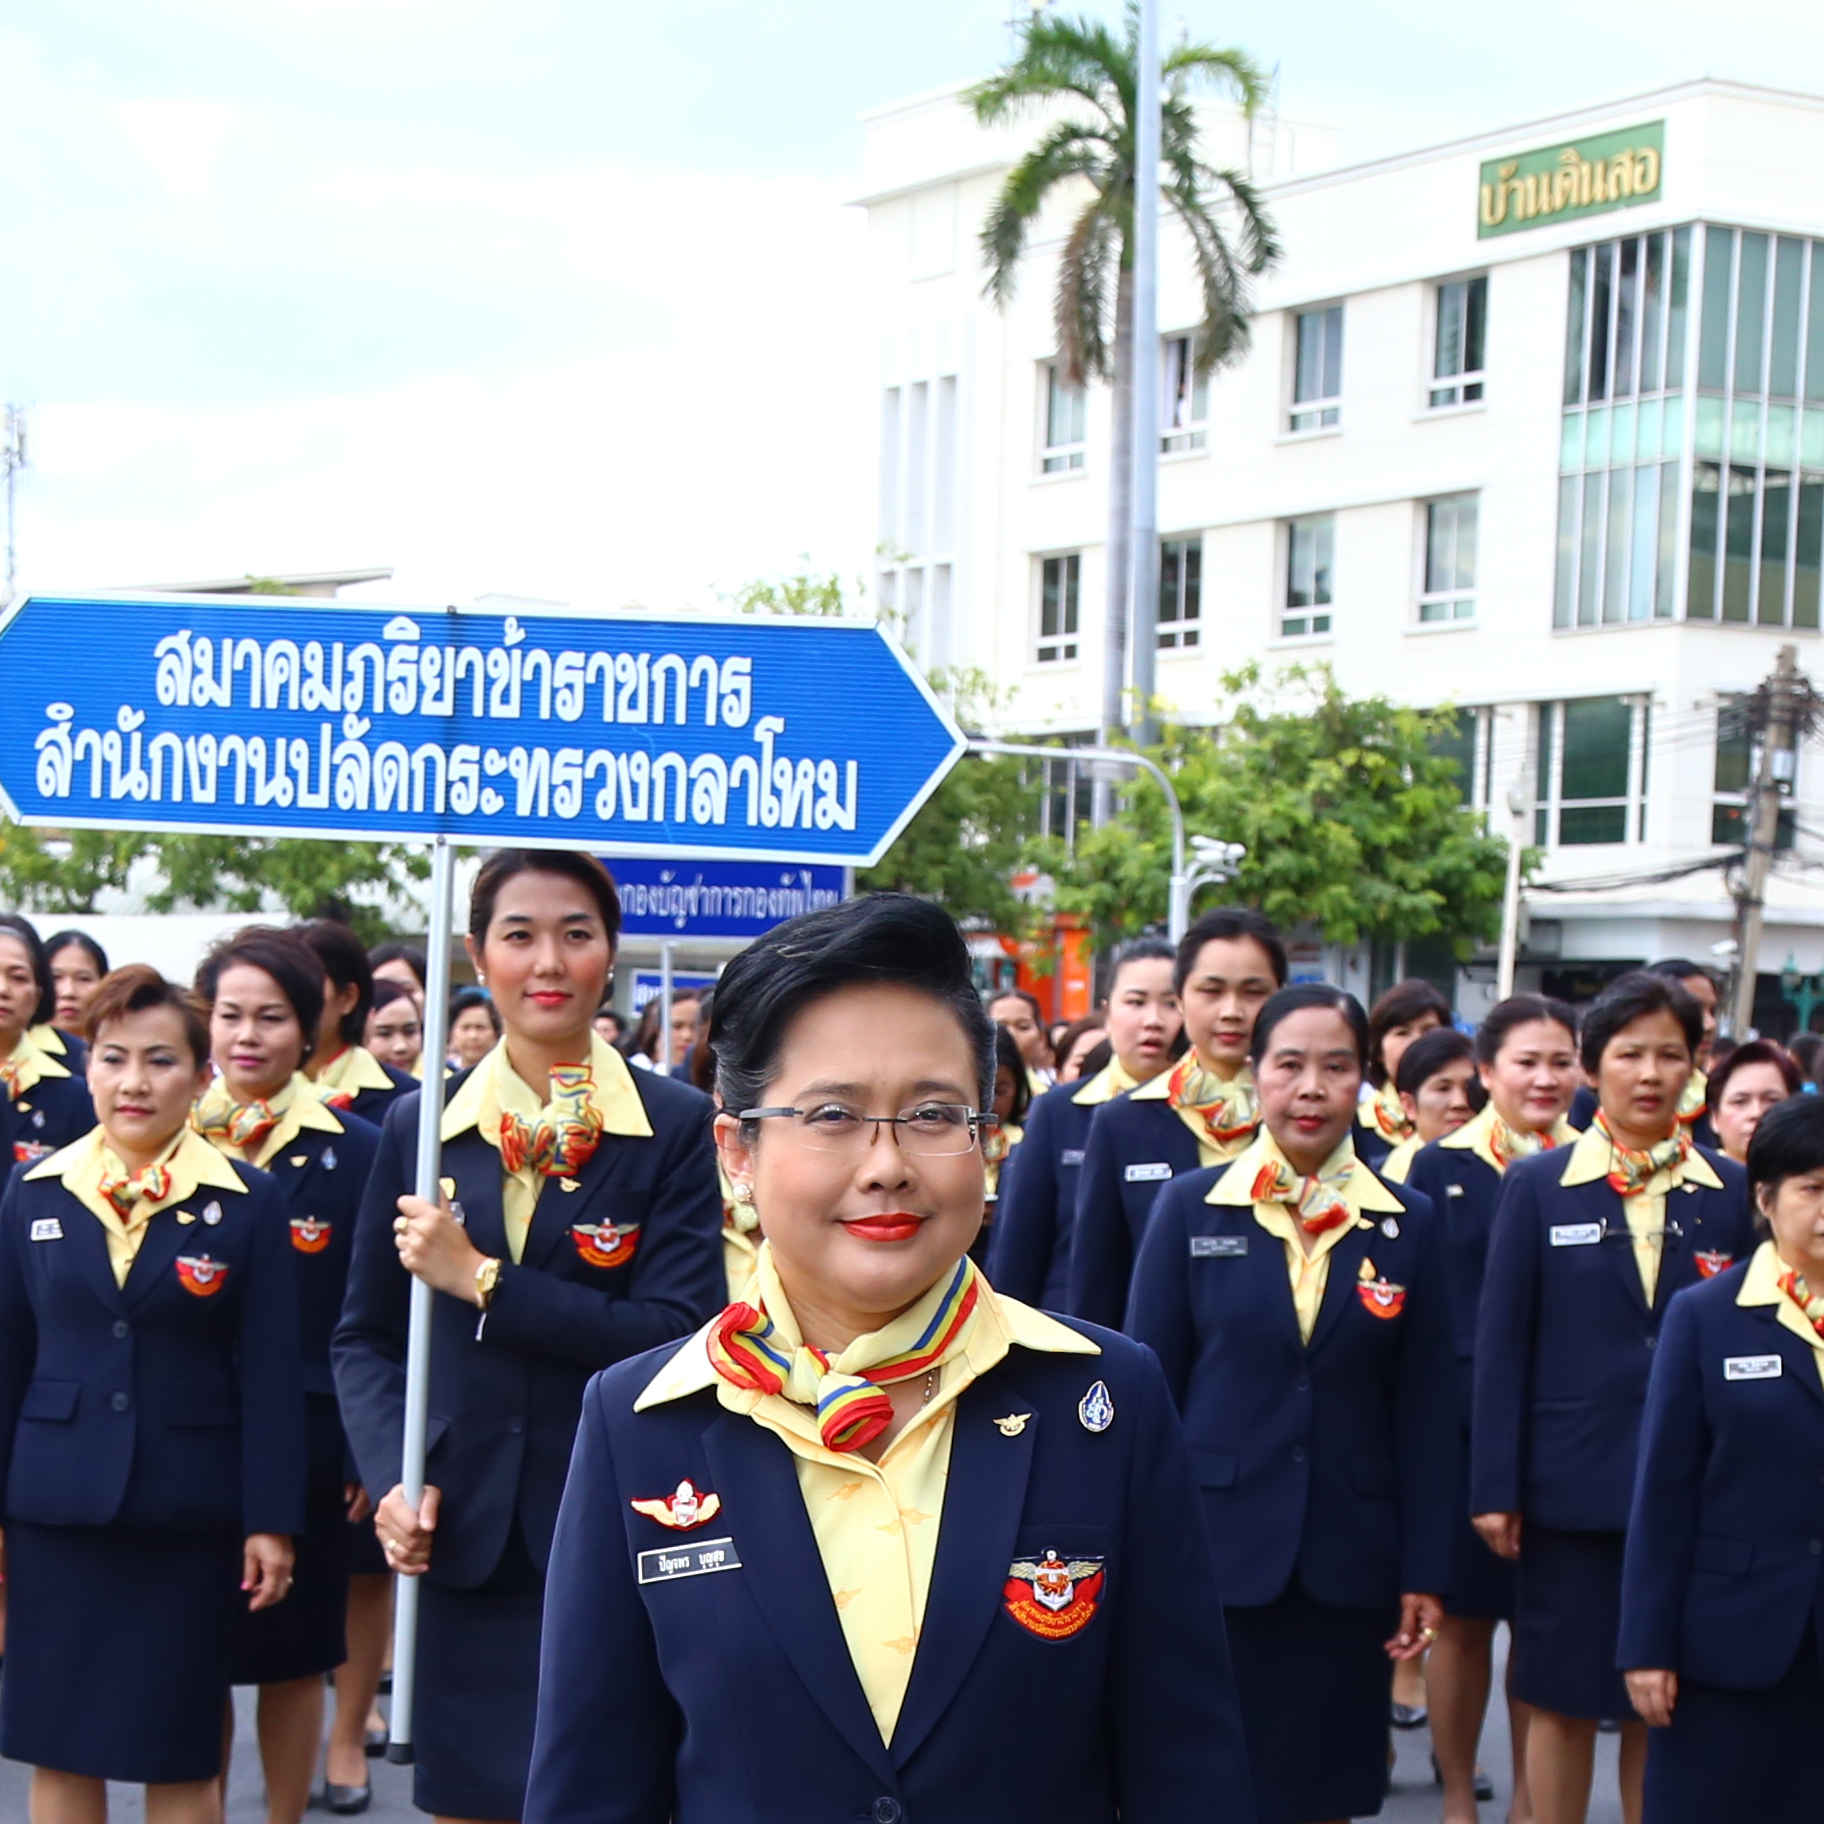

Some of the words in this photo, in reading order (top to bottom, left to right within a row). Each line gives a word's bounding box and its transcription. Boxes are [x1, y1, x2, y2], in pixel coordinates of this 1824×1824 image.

[153, 615, 752, 728] สมาคมภริยาข้าราชการ
[34, 703, 858, 832] สำนักงานปลัดกระทรวงกลาโหม
